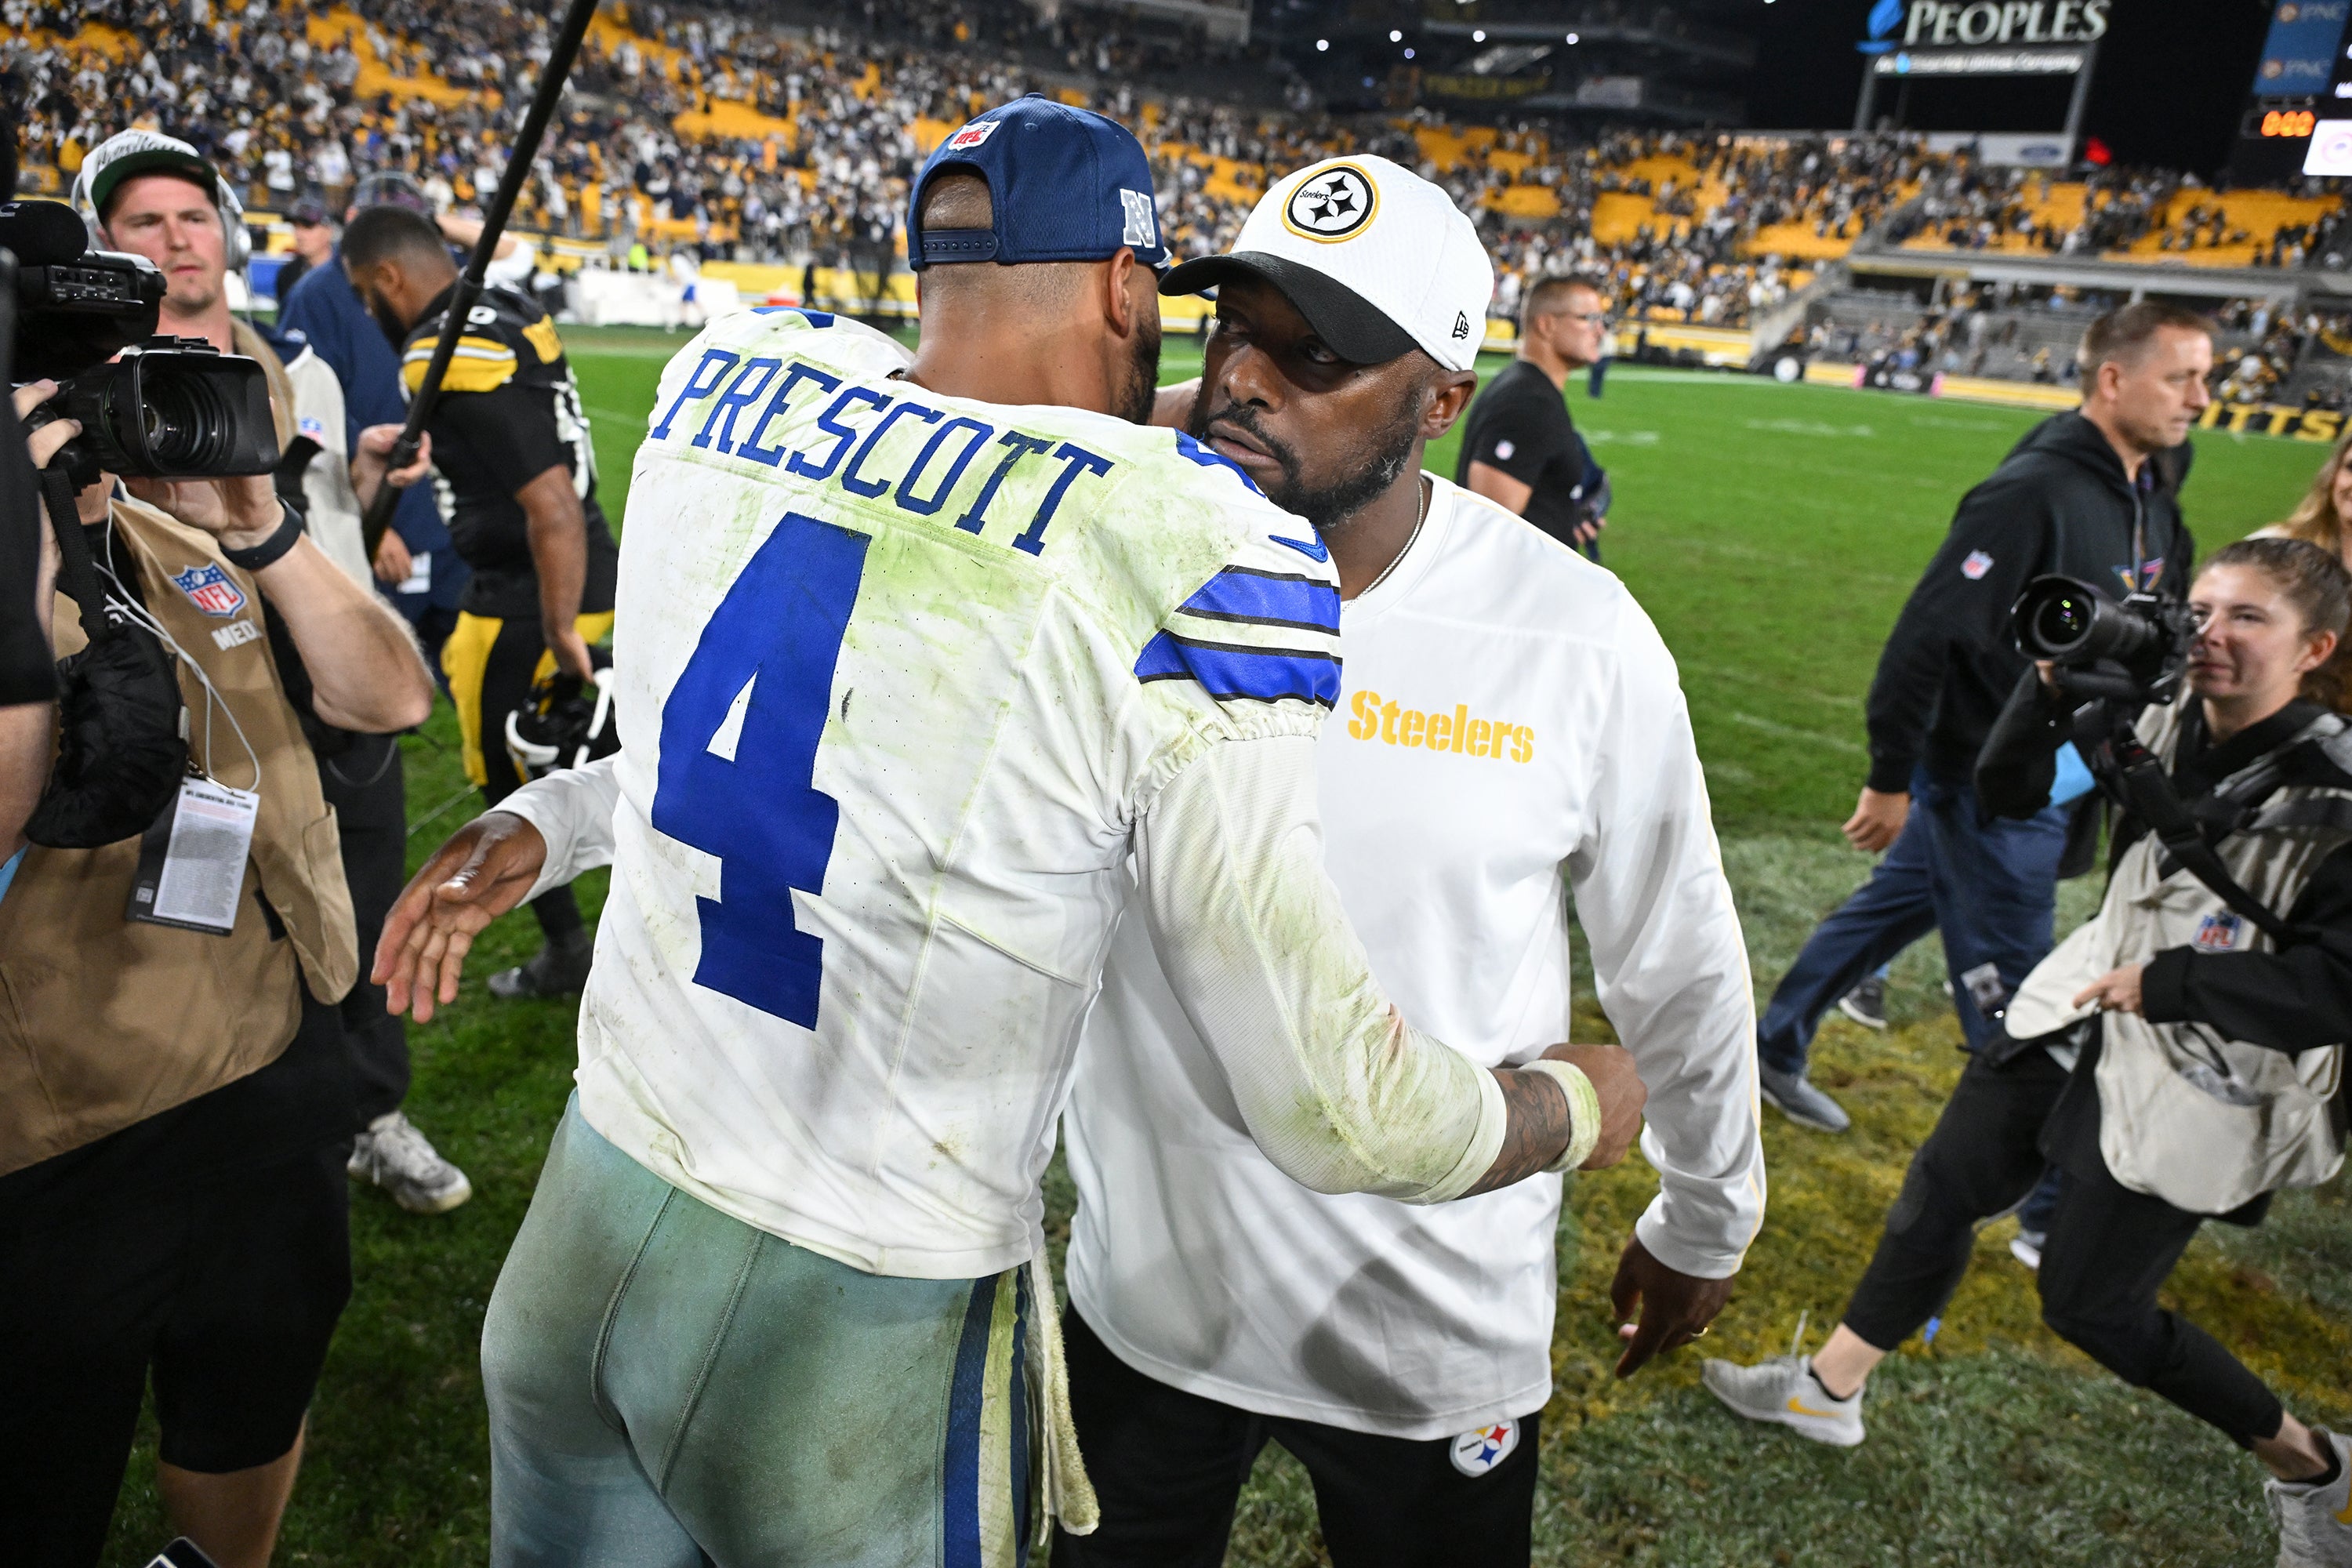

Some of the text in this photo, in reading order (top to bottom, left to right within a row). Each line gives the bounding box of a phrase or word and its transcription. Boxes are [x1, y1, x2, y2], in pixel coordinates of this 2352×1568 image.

[1904, 0, 2111, 44] PEOPLES
[1299, 190, 1330, 201] Steelers
[651, 349, 1114, 557] PRESCOTT
[191, 583, 239, 611] NFL
[1348, 690, 1534, 764] Steelers
[652, 512, 872, 1031] 4
